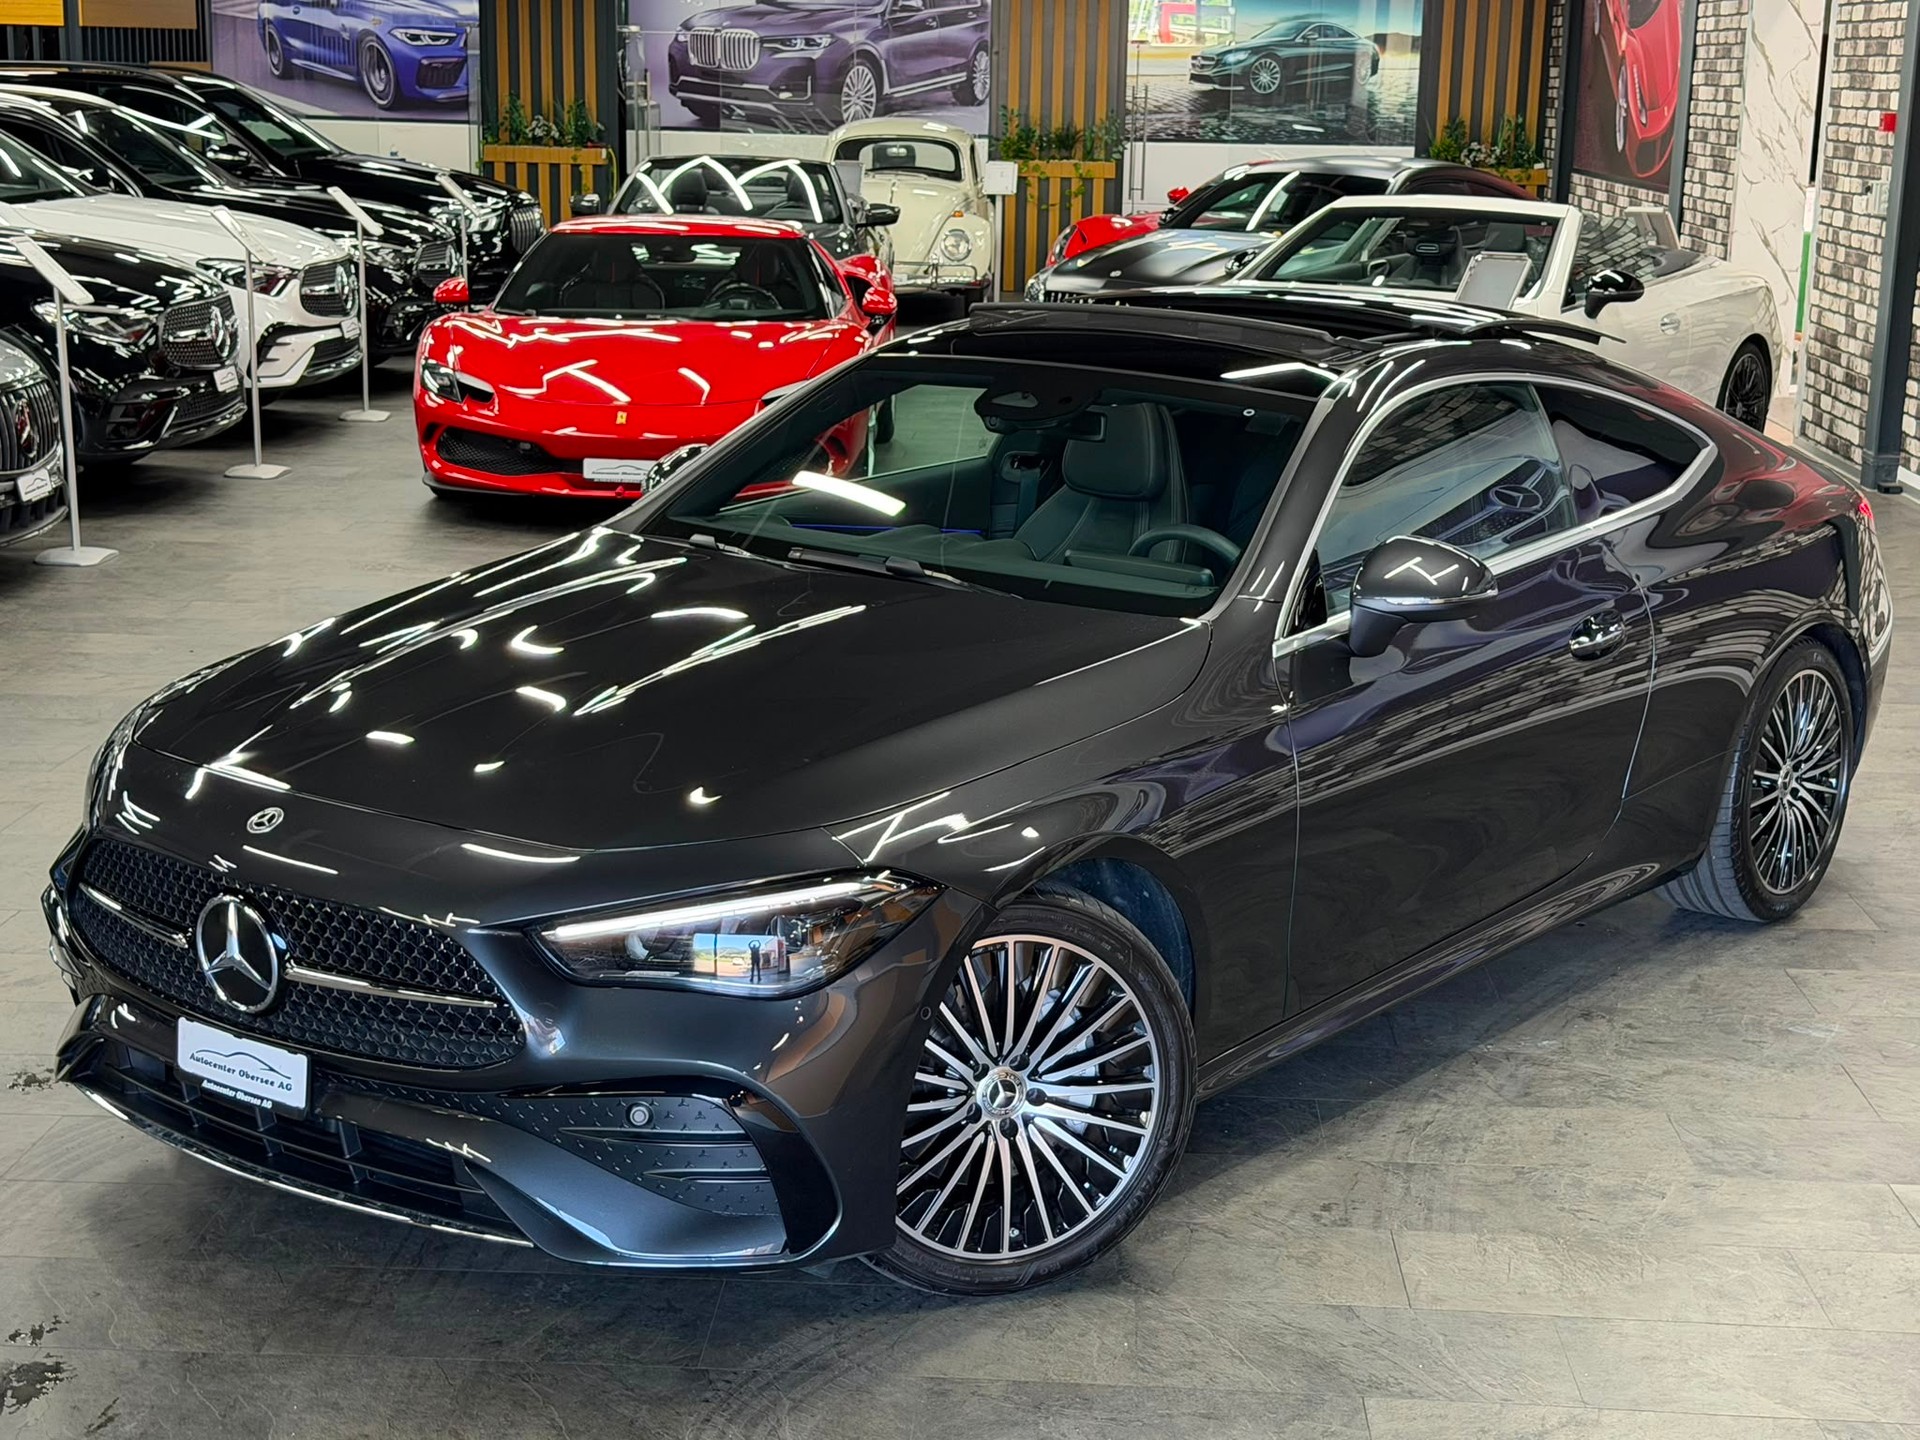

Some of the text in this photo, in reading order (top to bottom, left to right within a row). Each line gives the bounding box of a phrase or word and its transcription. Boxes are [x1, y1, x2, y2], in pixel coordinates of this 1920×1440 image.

[189, 1052, 293, 1092] Autocenter Obersee AG
